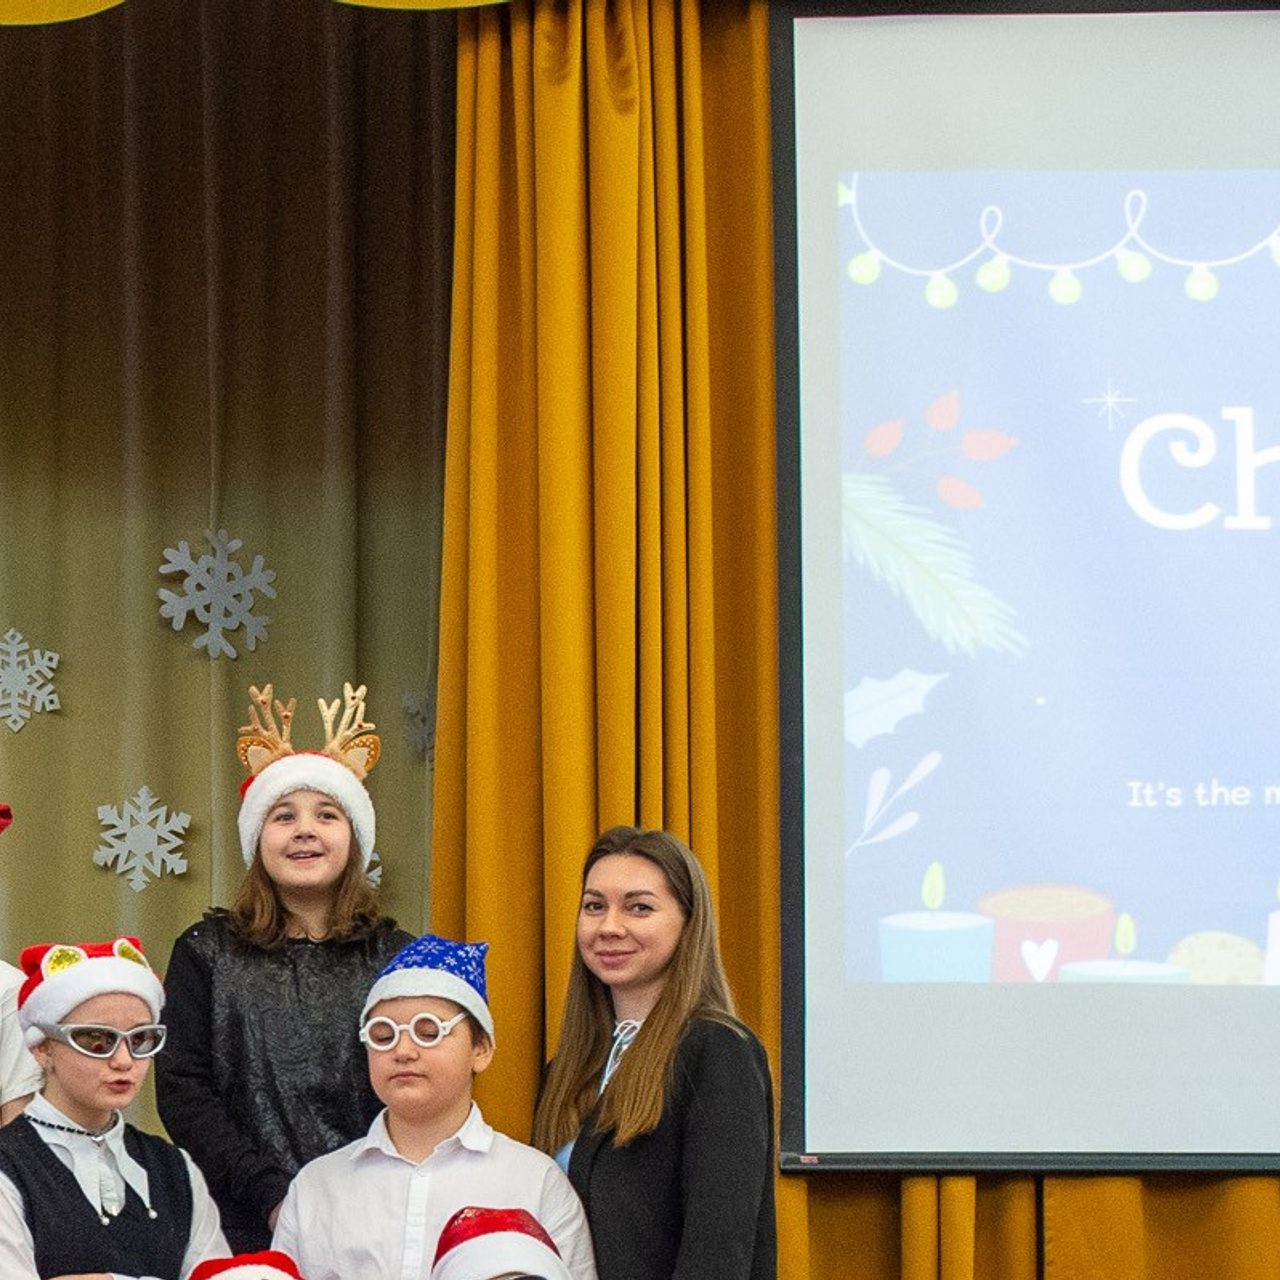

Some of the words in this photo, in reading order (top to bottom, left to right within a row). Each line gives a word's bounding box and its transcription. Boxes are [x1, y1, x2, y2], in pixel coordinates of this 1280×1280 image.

[1120, 406, 1280, 530] Ch
[1128, 781, 1182, 807] It's
[1195, 778, 1251, 807] the
